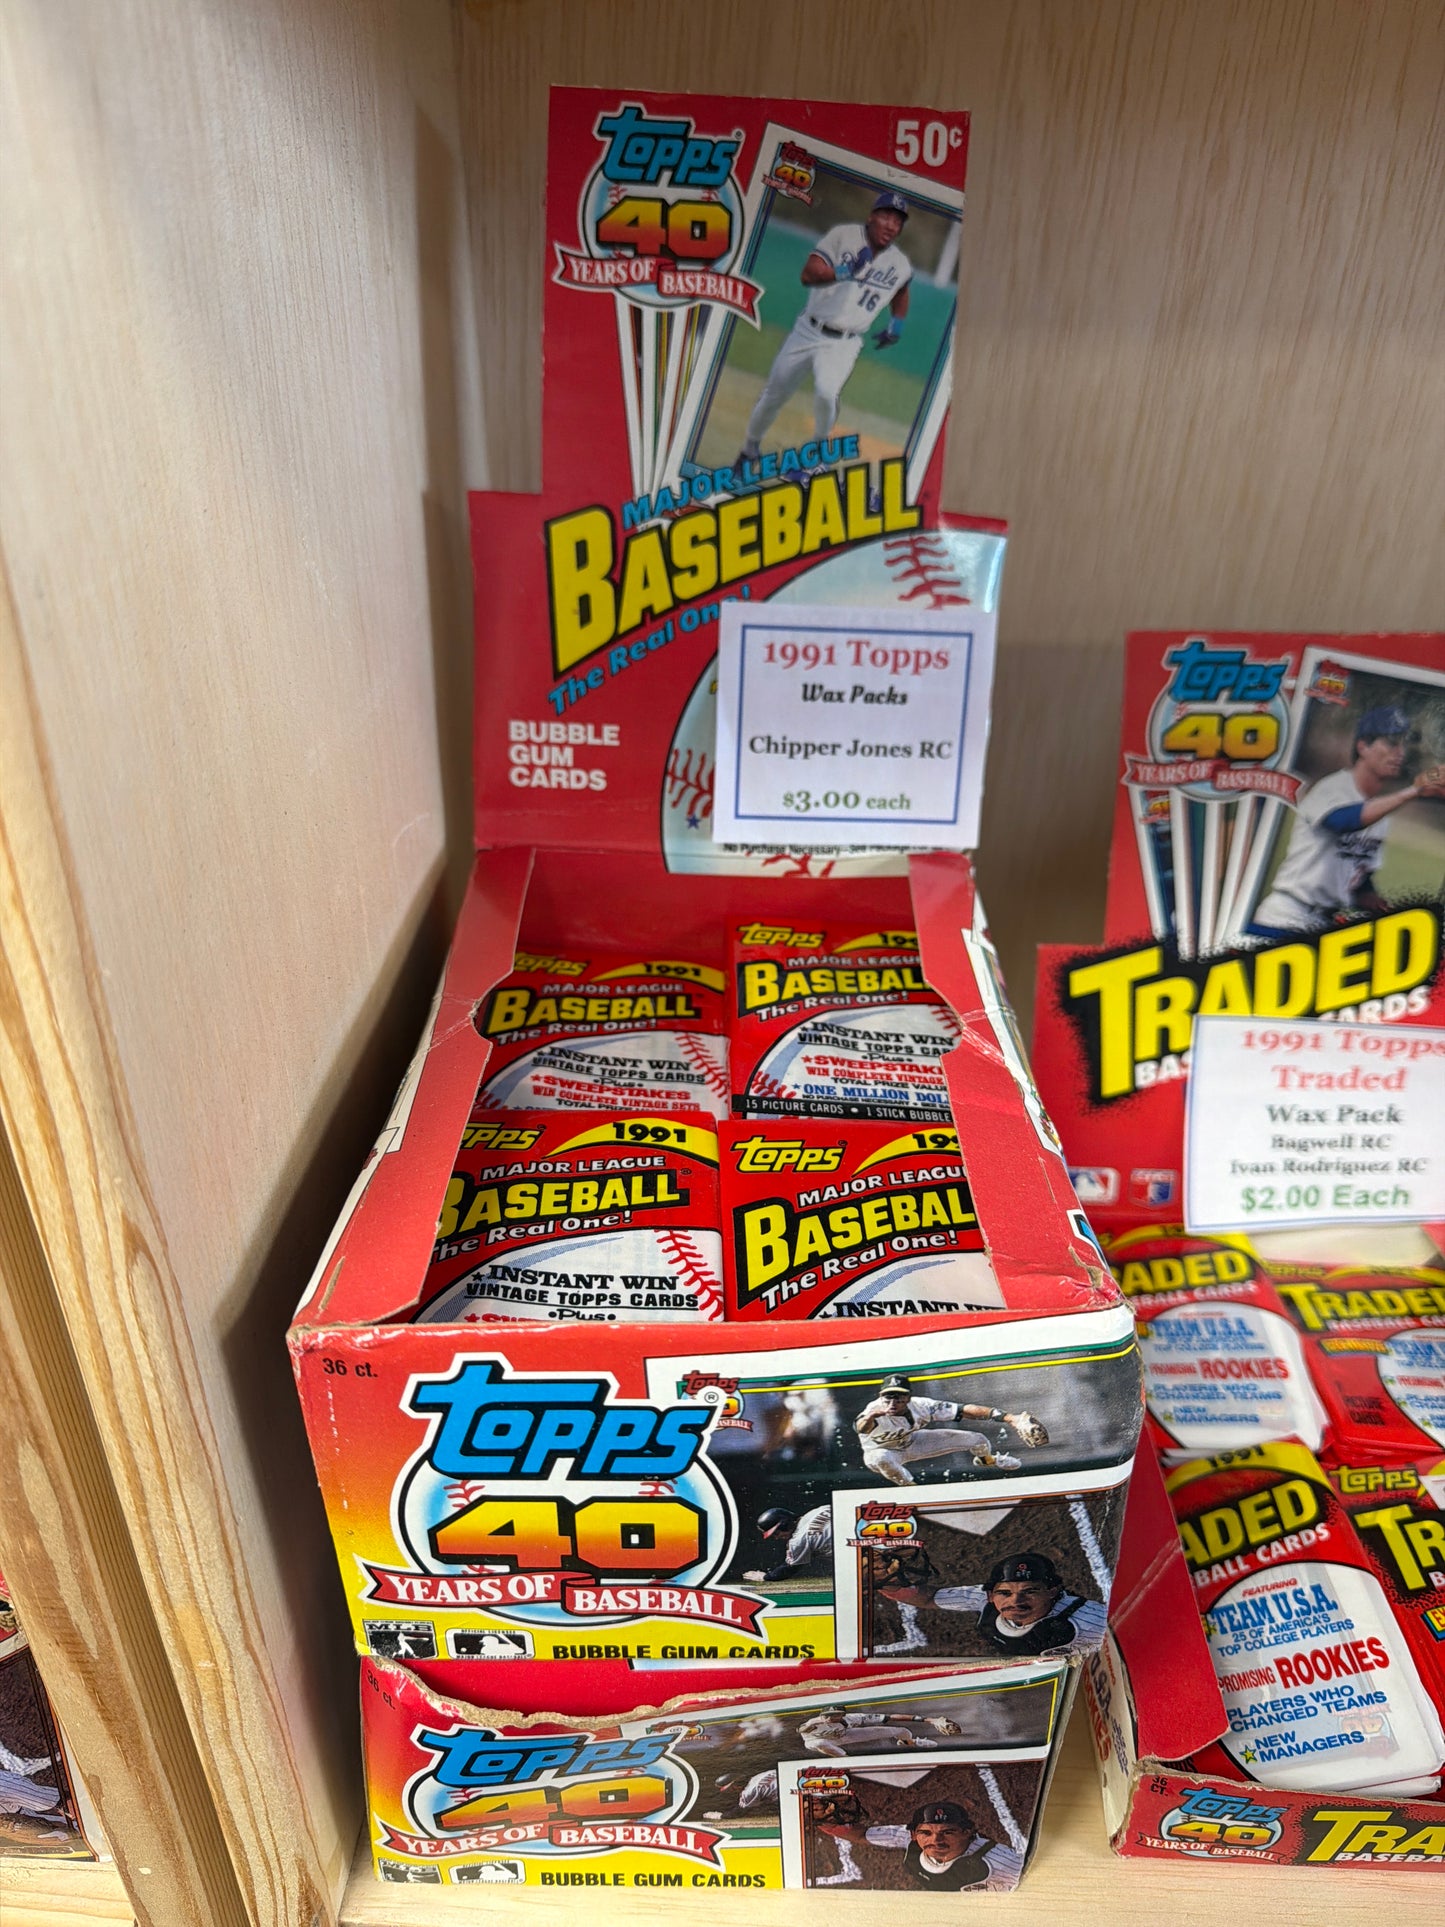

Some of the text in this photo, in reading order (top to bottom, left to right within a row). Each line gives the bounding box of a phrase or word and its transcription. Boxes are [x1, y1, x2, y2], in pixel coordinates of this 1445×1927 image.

[599, 107, 740, 187] Topps
[895, 120, 963, 166] 50¢
[596, 197, 732, 260] 40
[570, 259, 748, 307] YEARS OF BASEBALL
[857, 289, 880, 312] 16
[622, 434, 860, 530] MAJOR LEAGUE
[548, 459, 920, 674] BASEBALL
[548, 624, 674, 716] The Real
[763, 639, 949, 676] 1991 Topps
[1169, 642, 1287, 701] Topps
[802, 684, 908, 705] Wax Packs
[509, 721, 620, 746] BUBBLE
[1163, 713, 1280, 760] 40
[509, 745, 573, 767] GUM
[749, 736, 953, 760] Chipper Jones RC
[509, 768, 607, 790] CARDS
[1137, 763, 1292, 798] YEARS OF BASEBALL
[783, 791, 911, 812] $3.00 each
[738, 923, 824, 948] Topps
[645, 963, 702, 977] 1991
[787, 956, 851, 967] MAJOR
[543, 983, 683, 994] MAJOR LEAGUE
[486, 989, 696, 1035] BASEBALL
[757, 992, 908, 1022] The Real One!
[1069, 908, 1437, 1099] TRADED
[497, 1019, 656, 1045] The Real One!
[798, 1033, 913, 1055] VINTAGE TOPPS
[811, 1022, 953, 1046] INSTANT WIN
[1242, 1029, 1445, 1060] 1991 Topps
[532, 1056, 706, 1083] VINTAGE TOPPS CARDS
[550, 1047, 692, 1071] INSTANT WIN
[543, 1074, 691, 1100] SWEEPSTAKES
[806, 1067, 944, 1085] WIN COMPLETE VINTAGE
[831, 1077, 909, 1089] TOTAL PRIZE
[1272, 1065, 1410, 1092] Traded
[532, 1085, 555, 1097] WIN
[559, 1089, 619, 1105] COMPLETE
[622, 1097, 668, 1110] VINTAGE
[556, 1098, 594, 1108] TOTAL
[804, 1084, 909, 1100] ONE MILLION
[746, 1099, 949, 1122] 15 PICTURE CARDS 1 STICK BUBBLE
[1266, 1104, 1404, 1124] Wax Pack
[612, 1122, 686, 1142] 1991
[1271, 1134, 1392, 1153] Bagwell RC
[731, 1135, 845, 1172] Topps
[1231, 1157, 1430, 1176] Ivan Rodriguez RC
[482, 1156, 665, 1180] MAJOR LEAGUE
[798, 1175, 883, 1207] MAJOR
[1241, 1184, 1410, 1213] $2.00 Each
[488, 1211, 633, 1245] Real One!
[744, 1188, 975, 1291] BASEBAL
[489, 1265, 679, 1290] INSTANT WIN
[762, 1230, 958, 1313] The Real One!
[466, 1283, 698, 1308] VINTAGE TOPPS CARDS
[323, 1358, 378, 1378] 36 ct.
[1199, 1358, 1290, 1380] ROOKIES
[411, 1361, 717, 1480] Topps
[1329, 1465, 1419, 1494] Topps
[861, 1501, 915, 1520] Topps
[428, 1496, 707, 1580] 40
[861, 1522, 913, 1538] 40
[1256, 1522, 1330, 1562] CARDS
[388, 1575, 742, 1623] YEARS OF BASEBALL
[1242, 1578, 1297, 1597] FEATURING
[1213, 1584, 1338, 1635] TEAM U.S.A.
[366, 1623, 432, 1632] MLB
[1219, 1619, 1354, 1657] TOP COLLEGE PLAYERS
[1232, 1613, 1331, 1643] 25 OF AMERICA'S
[553, 1643, 815, 1659] BUBBLE GUM CARDS
[1219, 1637, 1390, 1694] PROMISING ROOKIES
[1228, 1685, 1354, 1721] PLAYERS WHO
[1230, 1691, 1387, 1733] CHANGED TEAMS
[1255, 1731, 1296, 1750] NEW
[1260, 1731, 1364, 1762] MANAGERS
[417, 1728, 679, 1787] Topps
[802, 1778, 847, 1788] 40
[1151, 1783, 1168, 1796] CT.
[1152, 1776, 1168, 1786] 36
[434, 1776, 672, 1832] 40
[1180, 1787, 1289, 1823] Topps
[403, 1824, 702, 1854] YEARS OF BASEBALL
[1168, 1821, 1274, 1849] 40
[1145, 1837, 1275, 1861] YEARS OF BASEBALL
[541, 1872, 765, 1888] BUBBLE GUM CARDS
